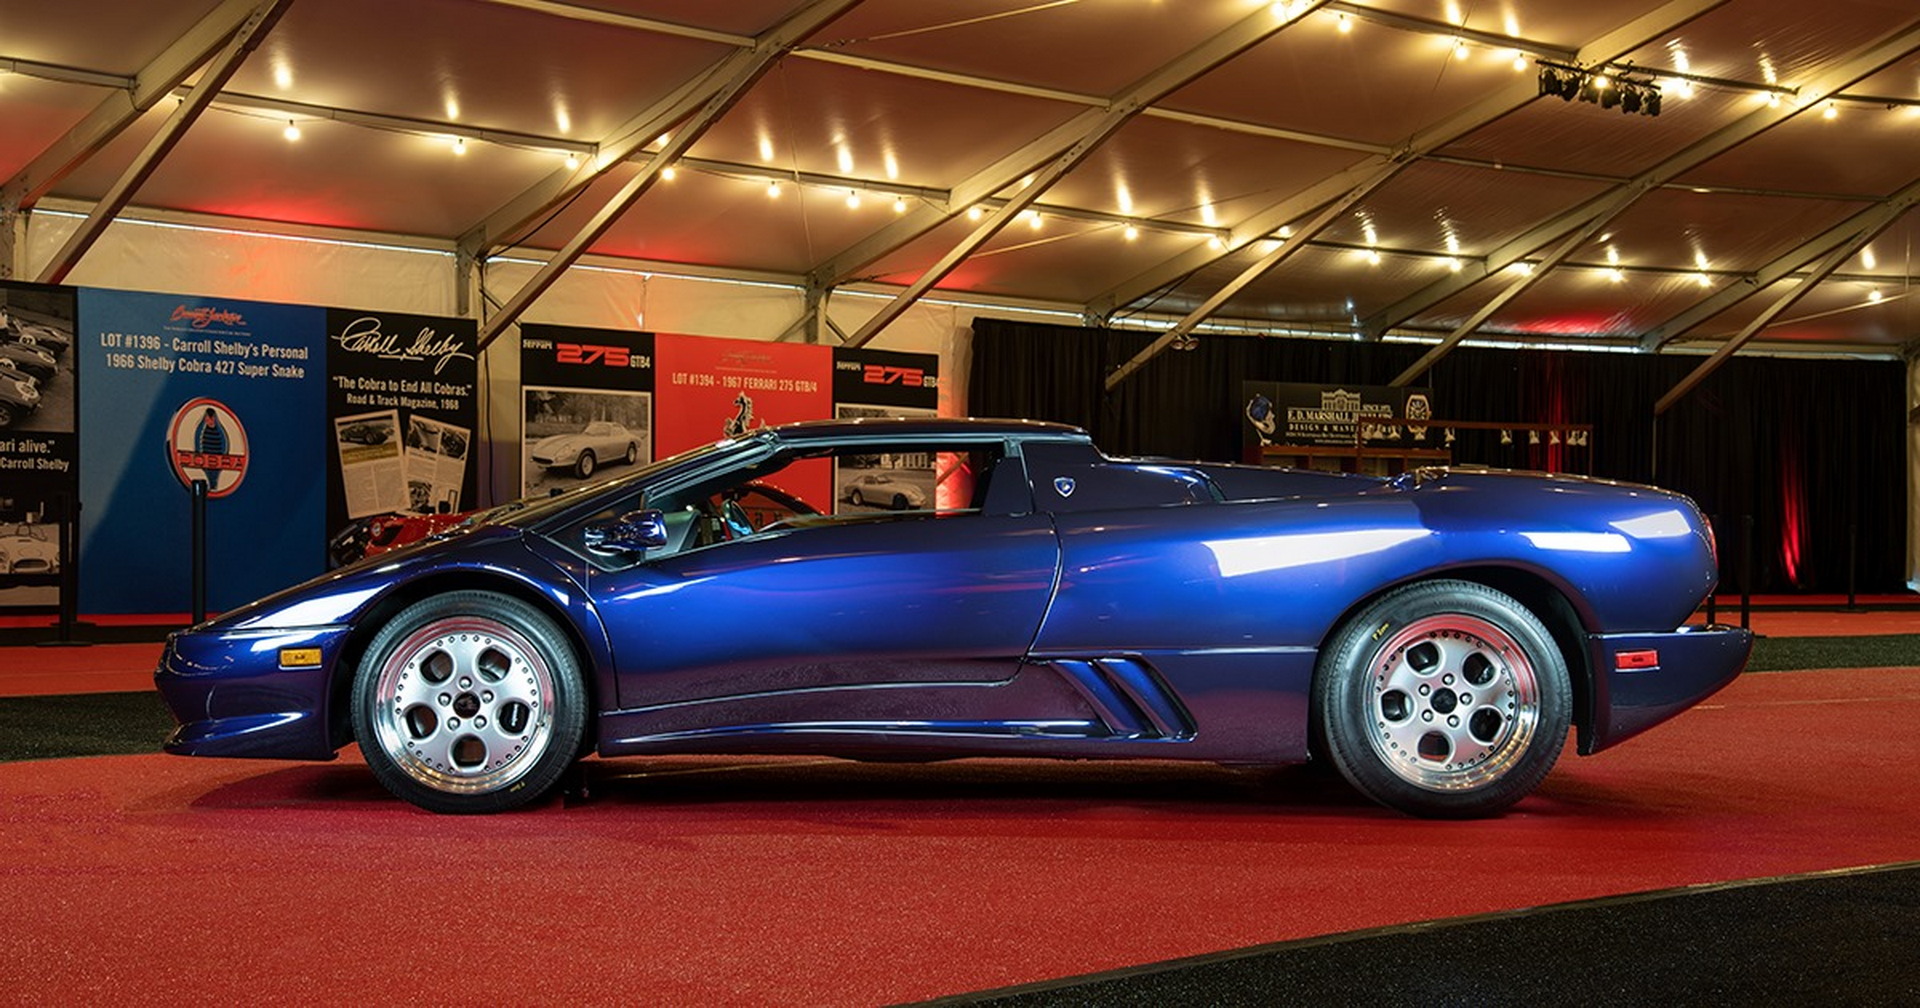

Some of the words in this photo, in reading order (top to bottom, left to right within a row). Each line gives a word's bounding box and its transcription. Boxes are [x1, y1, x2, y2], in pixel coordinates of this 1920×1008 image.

[100, 333, 121, 348] LOT
[125, 334, 161, 350] #1396
[172, 337, 211, 354] Carroll
[213, 340, 259, 359] Shelby's
[261, 344, 308, 360] Personal
[556, 343, 630, 367] 275
[106, 353, 135, 368] 1966
[137, 355, 176, 373] Shelby
[178, 358, 212, 373] Cobra
[214, 360, 235, 375] 427
[237, 362, 269, 378] Super
[271, 363, 305, 379] Snake
[863, 364, 924, 387] 275
[357, 377, 387, 391] Cobra
[388, 379, 399, 392] to
[401, 379, 418, 393] End
[419, 381, 433, 394] All
[672, 372, 688, 385] LOT
[743, 377, 778, 391] FERRARI
[778, 379, 794, 391] 275
[346, 393, 368, 404] Road
[377, 394, 399, 406] Track
[1306, 411, 1351, 421] MARSHALL
[0, 456, 35, 469] Carroll
[36, 457, 70, 472] Shelby
